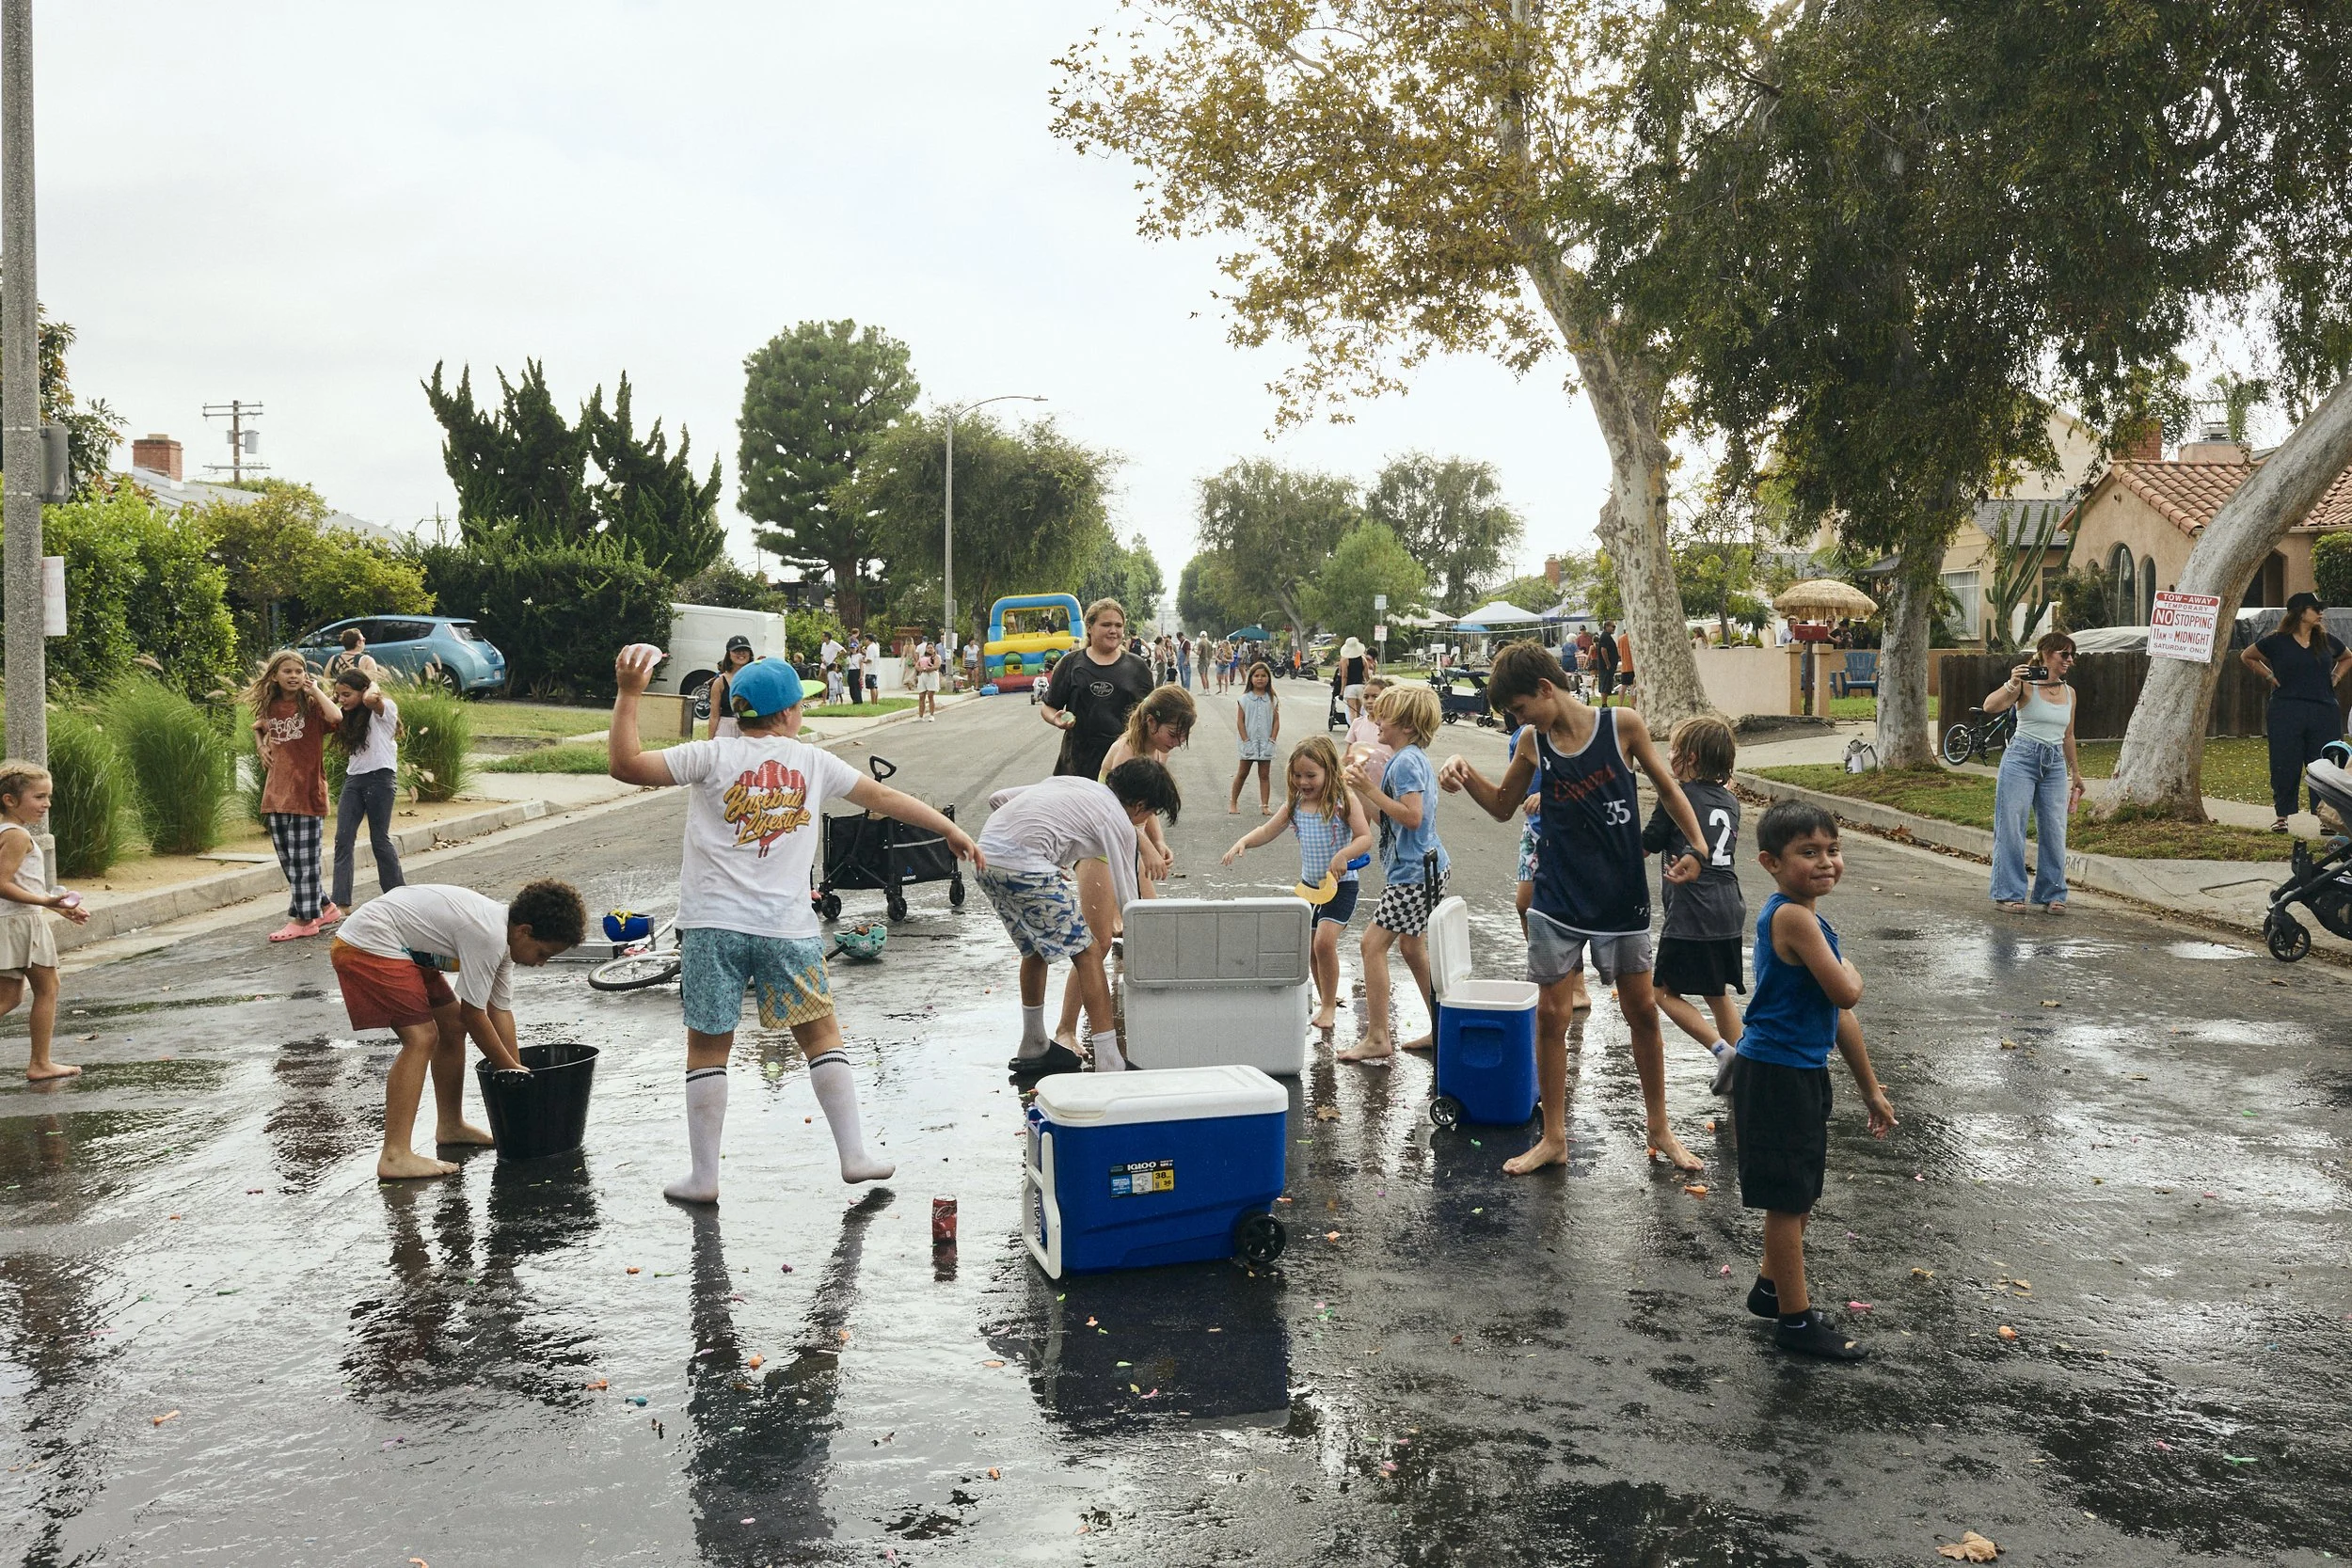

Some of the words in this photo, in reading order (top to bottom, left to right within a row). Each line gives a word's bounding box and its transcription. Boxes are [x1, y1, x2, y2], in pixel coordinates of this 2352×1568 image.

[2164, 602, 2209, 611] TEMPORARY
[2154, 610, 2173, 625] NO
[2174, 613, 2213, 629] STOPPING
[2153, 642, 2187, 652] SATURDAY
[2174, 630, 2211, 646] MIDNIGHT
[723, 783, 804, 823] Baseball
[1602, 799, 1631, 826] 35
[733, 809, 811, 847] Lifestyle
[1708, 808, 1732, 866] 2
[1127, 1162, 1156, 1171] IGLOO
